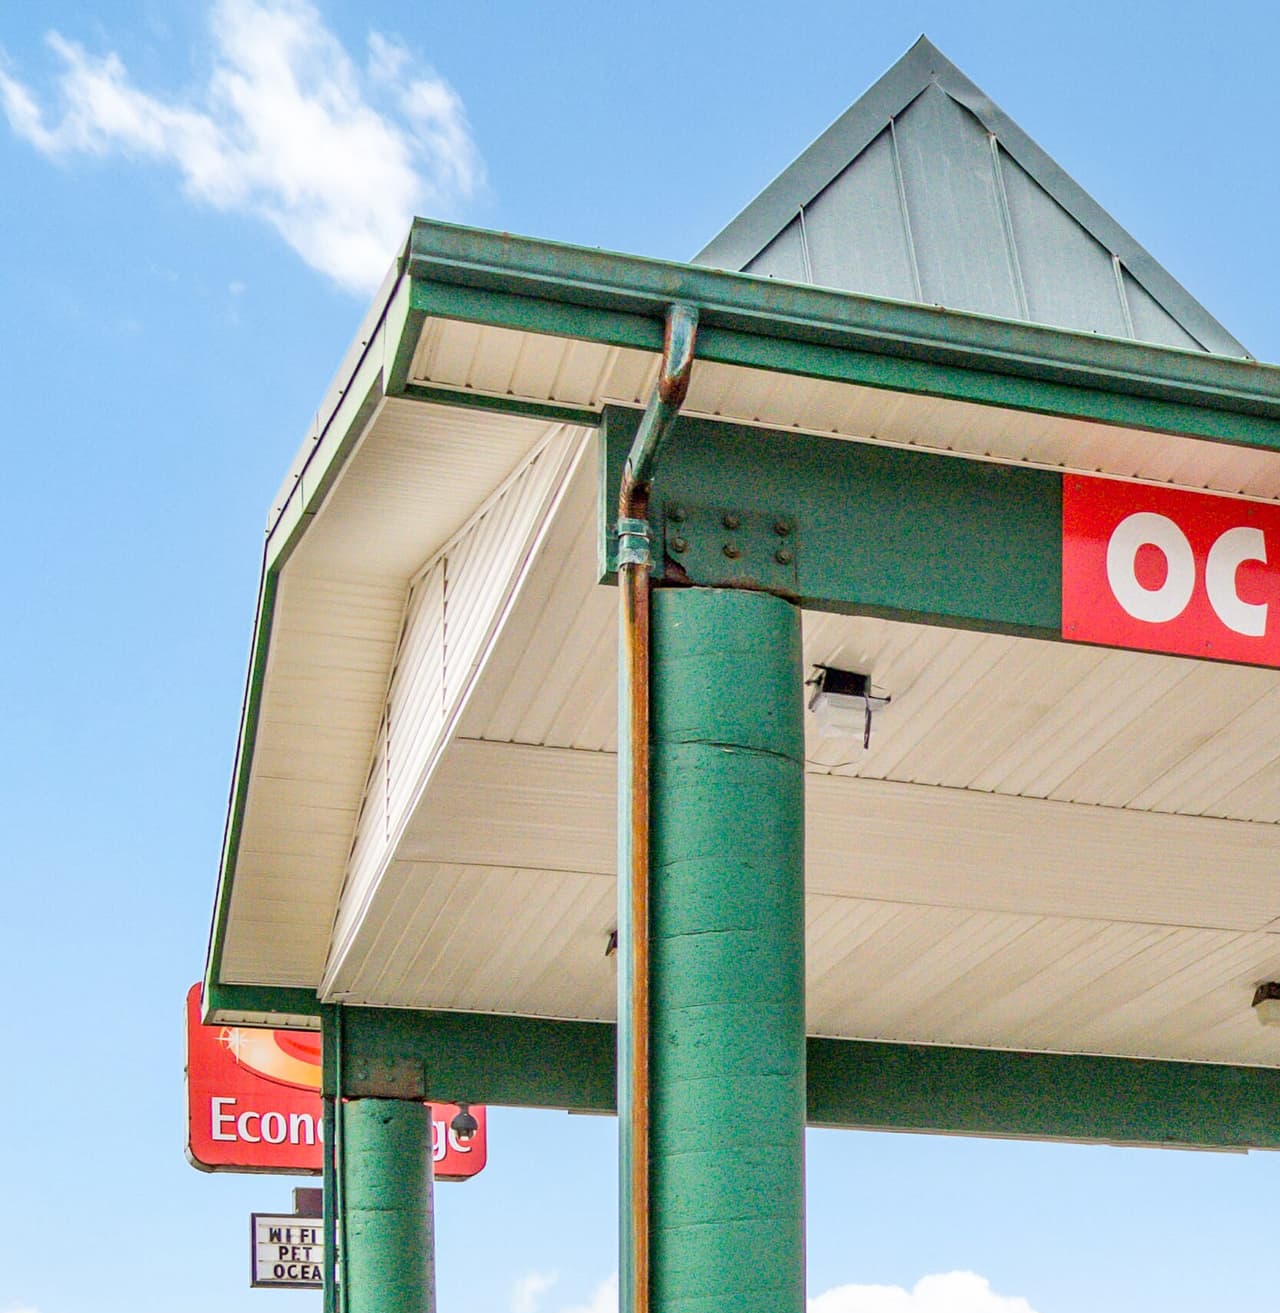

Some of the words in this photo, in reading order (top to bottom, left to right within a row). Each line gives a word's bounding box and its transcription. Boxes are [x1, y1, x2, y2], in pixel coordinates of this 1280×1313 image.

[211, 1096, 475, 1162] Econge
[279, 1246, 312, 1261] PET
[274, 1264, 322, 1280] OCEA
